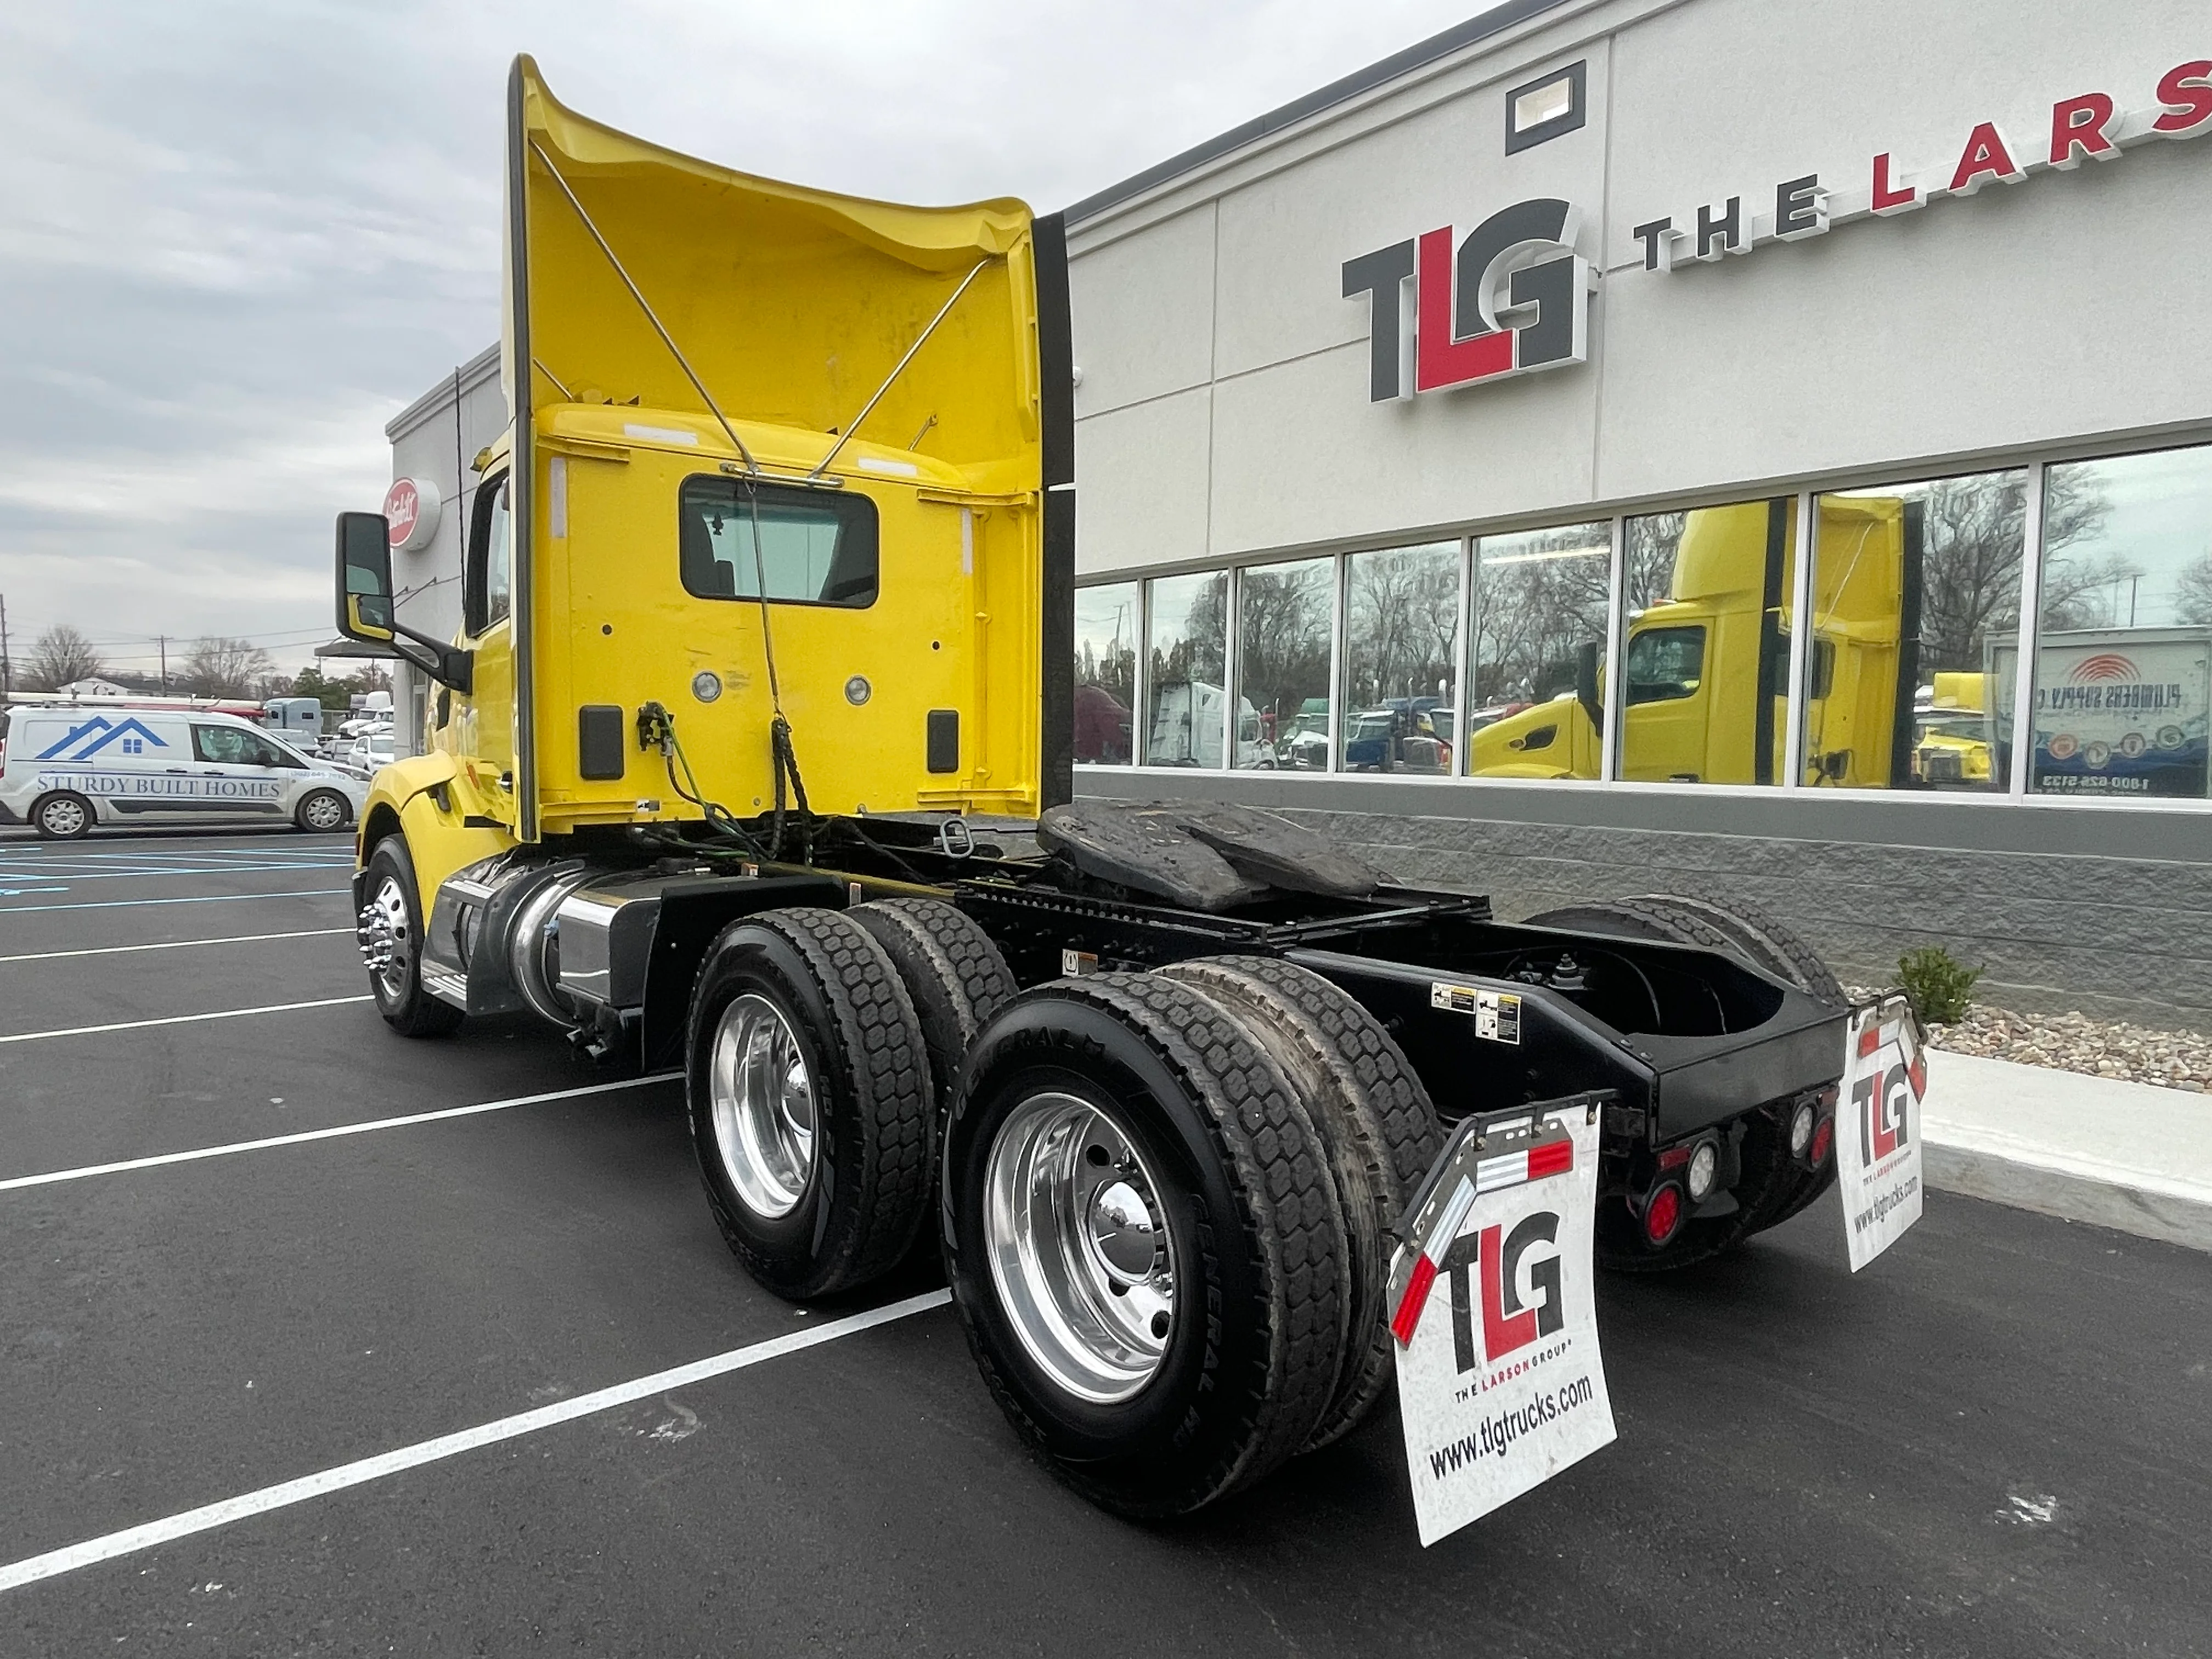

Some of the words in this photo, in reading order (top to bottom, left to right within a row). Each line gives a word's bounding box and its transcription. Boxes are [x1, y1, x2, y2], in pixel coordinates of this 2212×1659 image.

[1633, 173, 1822, 270] THE
[1342, 198, 1580, 403] TLG
[37, 776, 130, 793] STURDY
[136, 779, 198, 796] BUILT
[205, 781, 281, 798] HOMES
[1852, 1062, 1908, 1169] TLG
[1438, 1211, 1564, 1375] TLG
[1430, 1375, 1593, 1480] www.tlgtrucks.com
[1455, 1383, 1478, 1403] THE
[1482, 1359, 1530, 1392] LARSON
